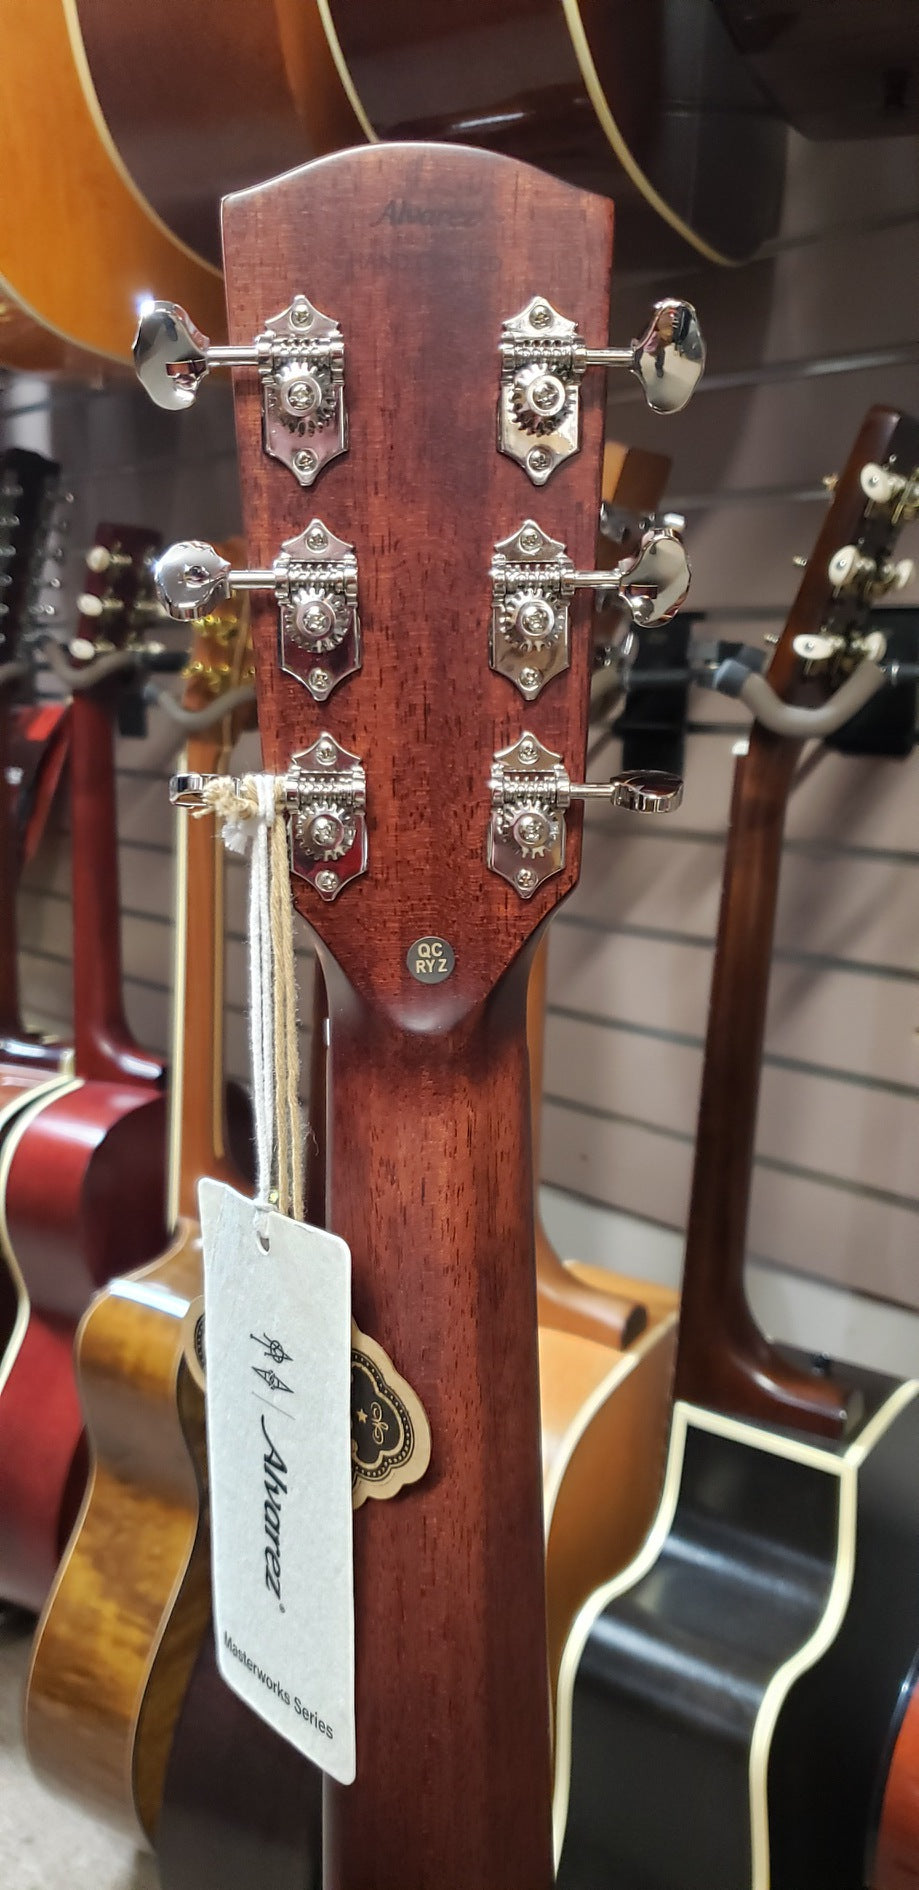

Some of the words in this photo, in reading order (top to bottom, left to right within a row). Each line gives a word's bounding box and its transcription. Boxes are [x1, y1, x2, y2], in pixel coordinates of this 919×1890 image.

[418, 942, 443, 958] QC
[224, 1630, 291, 1706] Masterworks
[293, 1696, 334, 1740] Series
